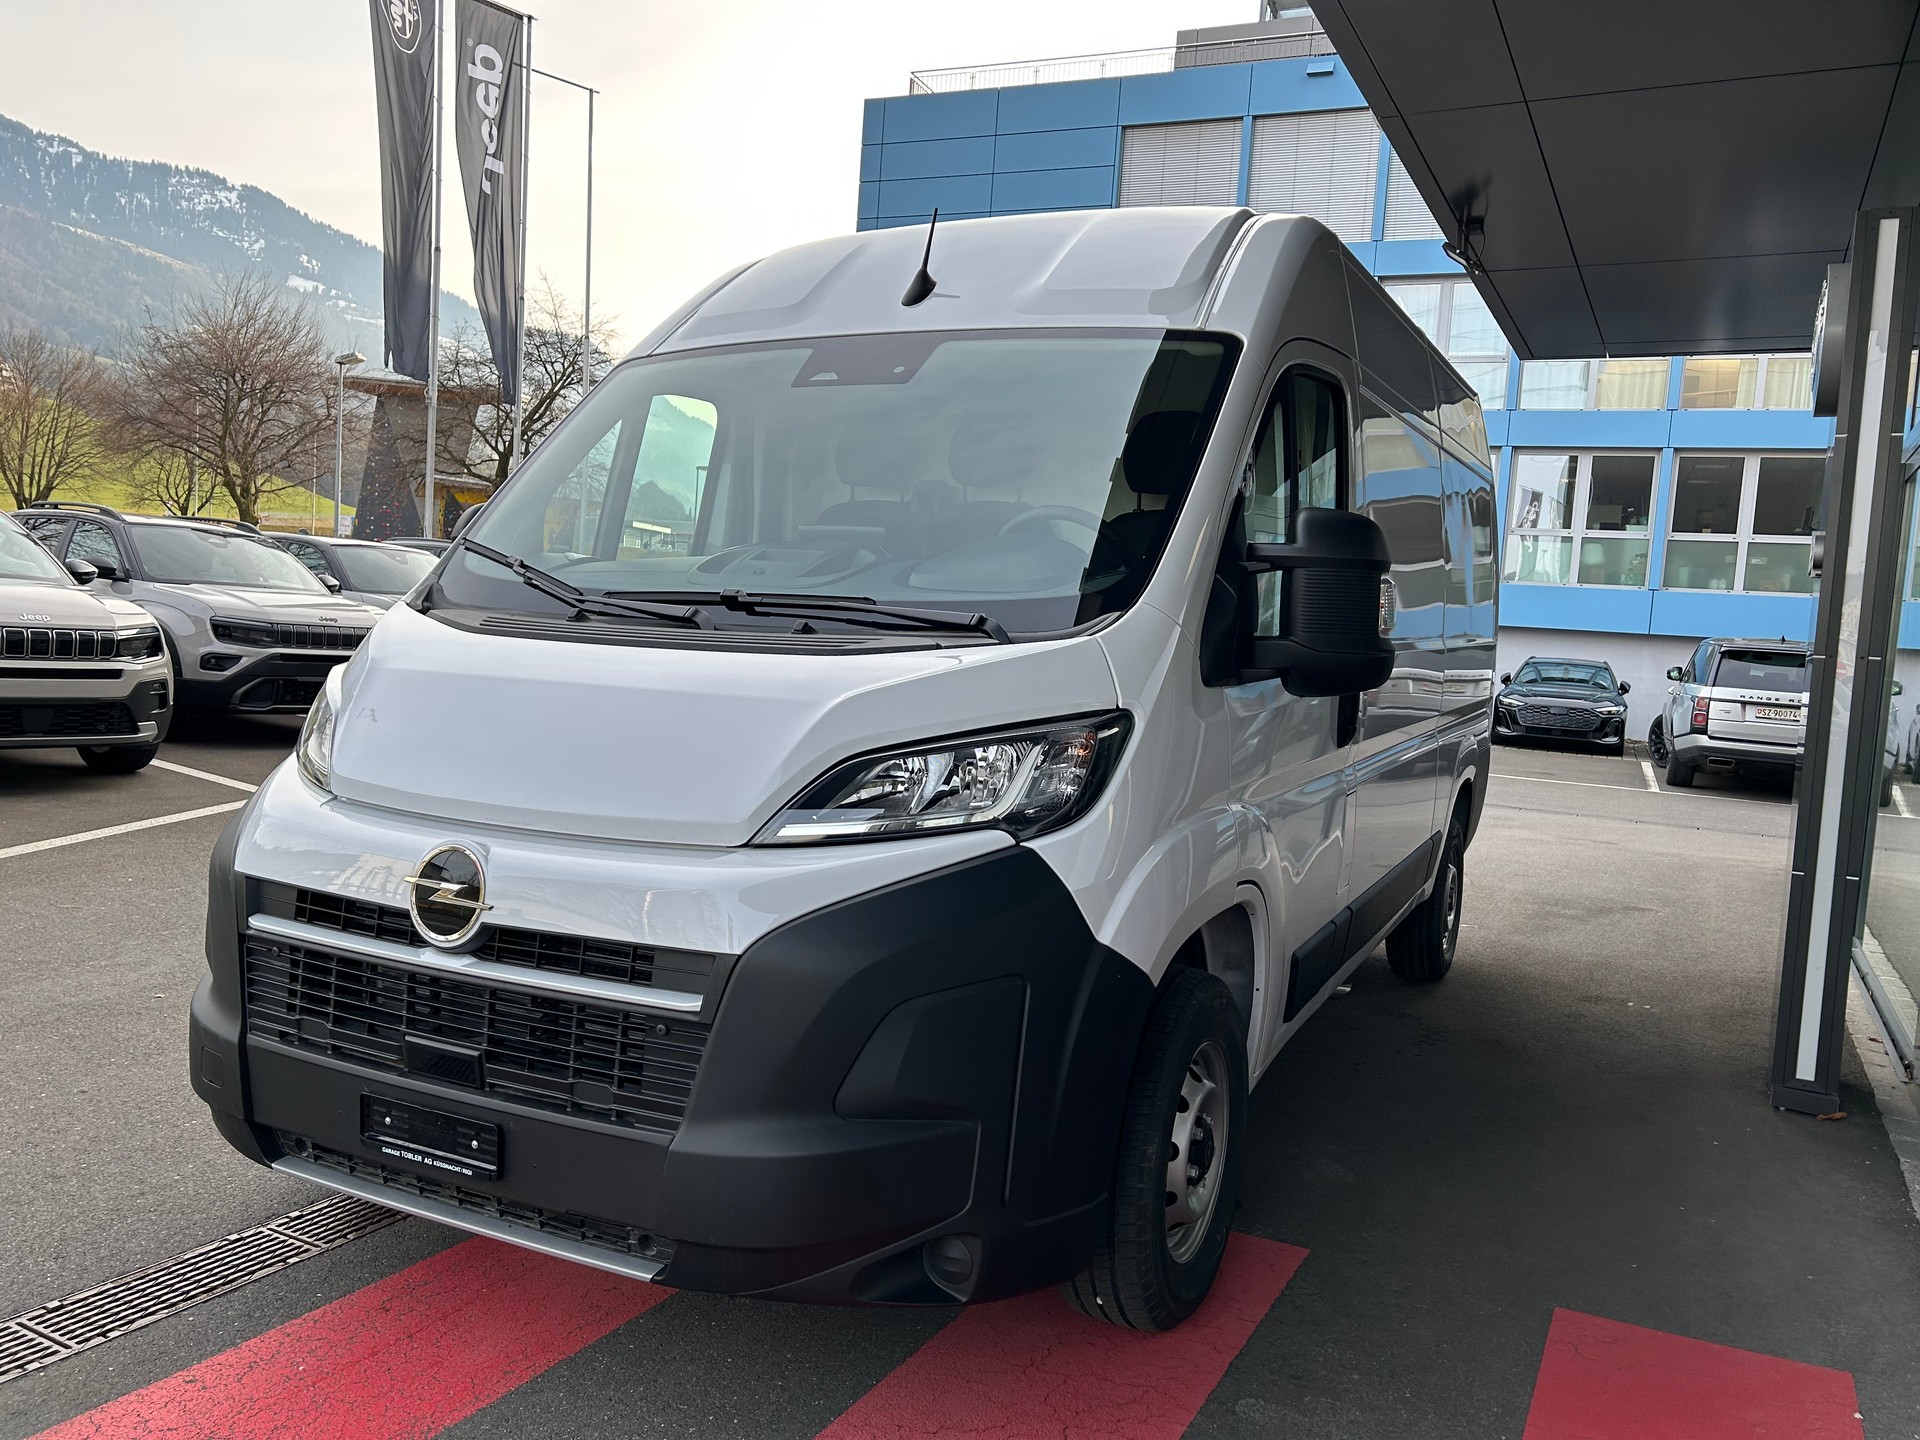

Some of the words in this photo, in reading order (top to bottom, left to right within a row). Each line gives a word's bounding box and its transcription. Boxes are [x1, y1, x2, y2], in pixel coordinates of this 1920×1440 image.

[20, 613, 51, 622] Jeep
[382, 1147, 400, 1157] GARAGE
[401, 1151, 423, 1162] TOBLER
[423, 1157, 433, 1165] AG
